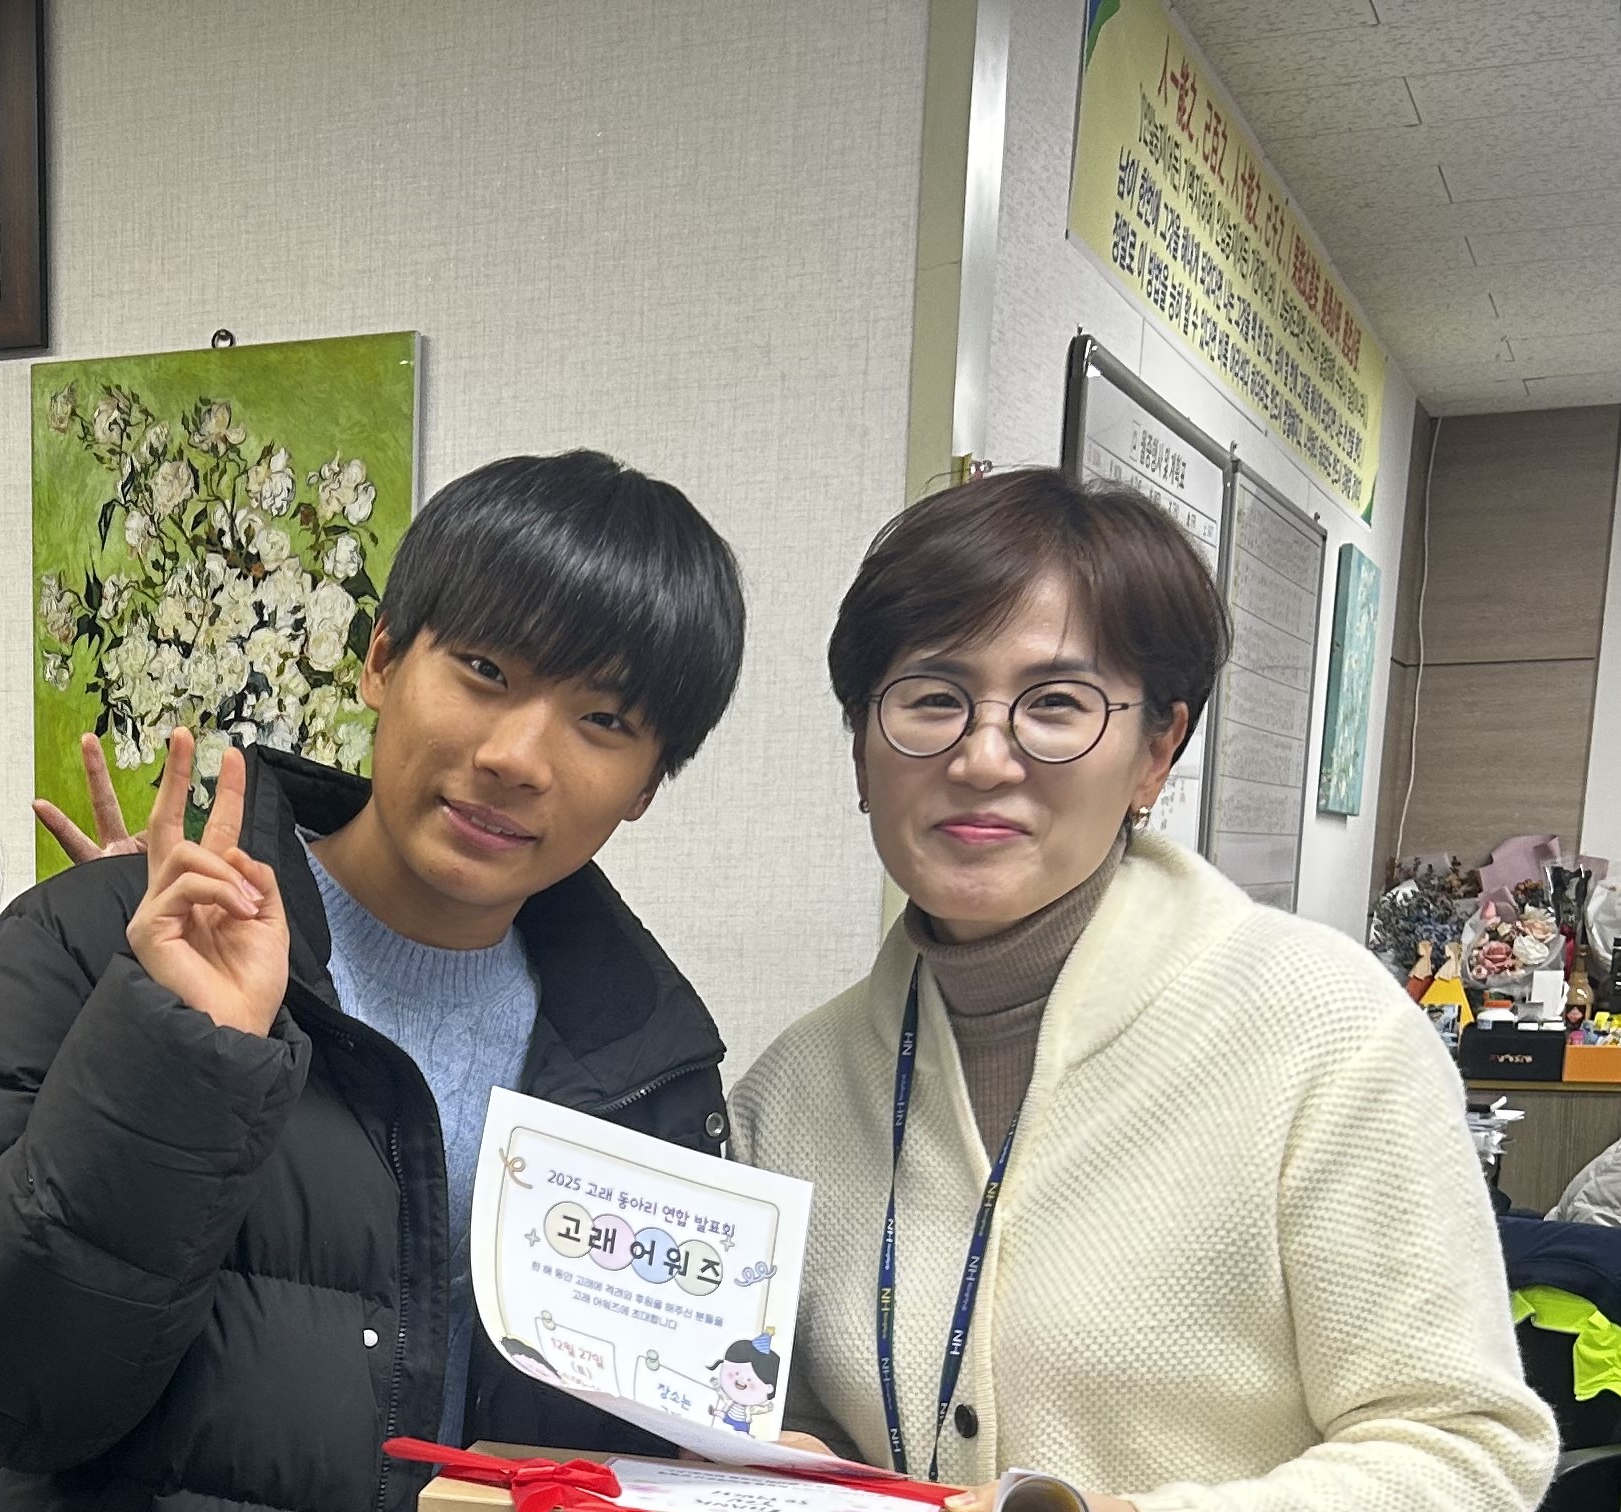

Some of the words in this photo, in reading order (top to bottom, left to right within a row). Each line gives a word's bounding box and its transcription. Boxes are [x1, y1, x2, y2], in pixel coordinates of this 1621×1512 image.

[902, 1032, 914, 1056] NH
[895, 1101, 909, 1126] NH
[547, 1170, 582, 1191] 2025
[585, 1183, 613, 1201] 고래
[617, 1192, 657, 1215] 동아리
[662, 1205, 690, 1227] 연합
[694, 1215, 736, 1238] 발표회
[886, 1218, 894, 1243] NH
[557, 1215, 617, 1254] 고래
[630, 1240, 721, 1287] 어워즈
[966, 1256, 980, 1282] NH
[573, 1289, 591, 1303] 고래
[632, 1309, 677, 1330] 초대합니다
[881, 1287, 892, 1312] NH
[950, 1330, 964, 1356] NH
[657, 1383, 693, 1411] 장소는
[889, 1428, 902, 1453] NH
